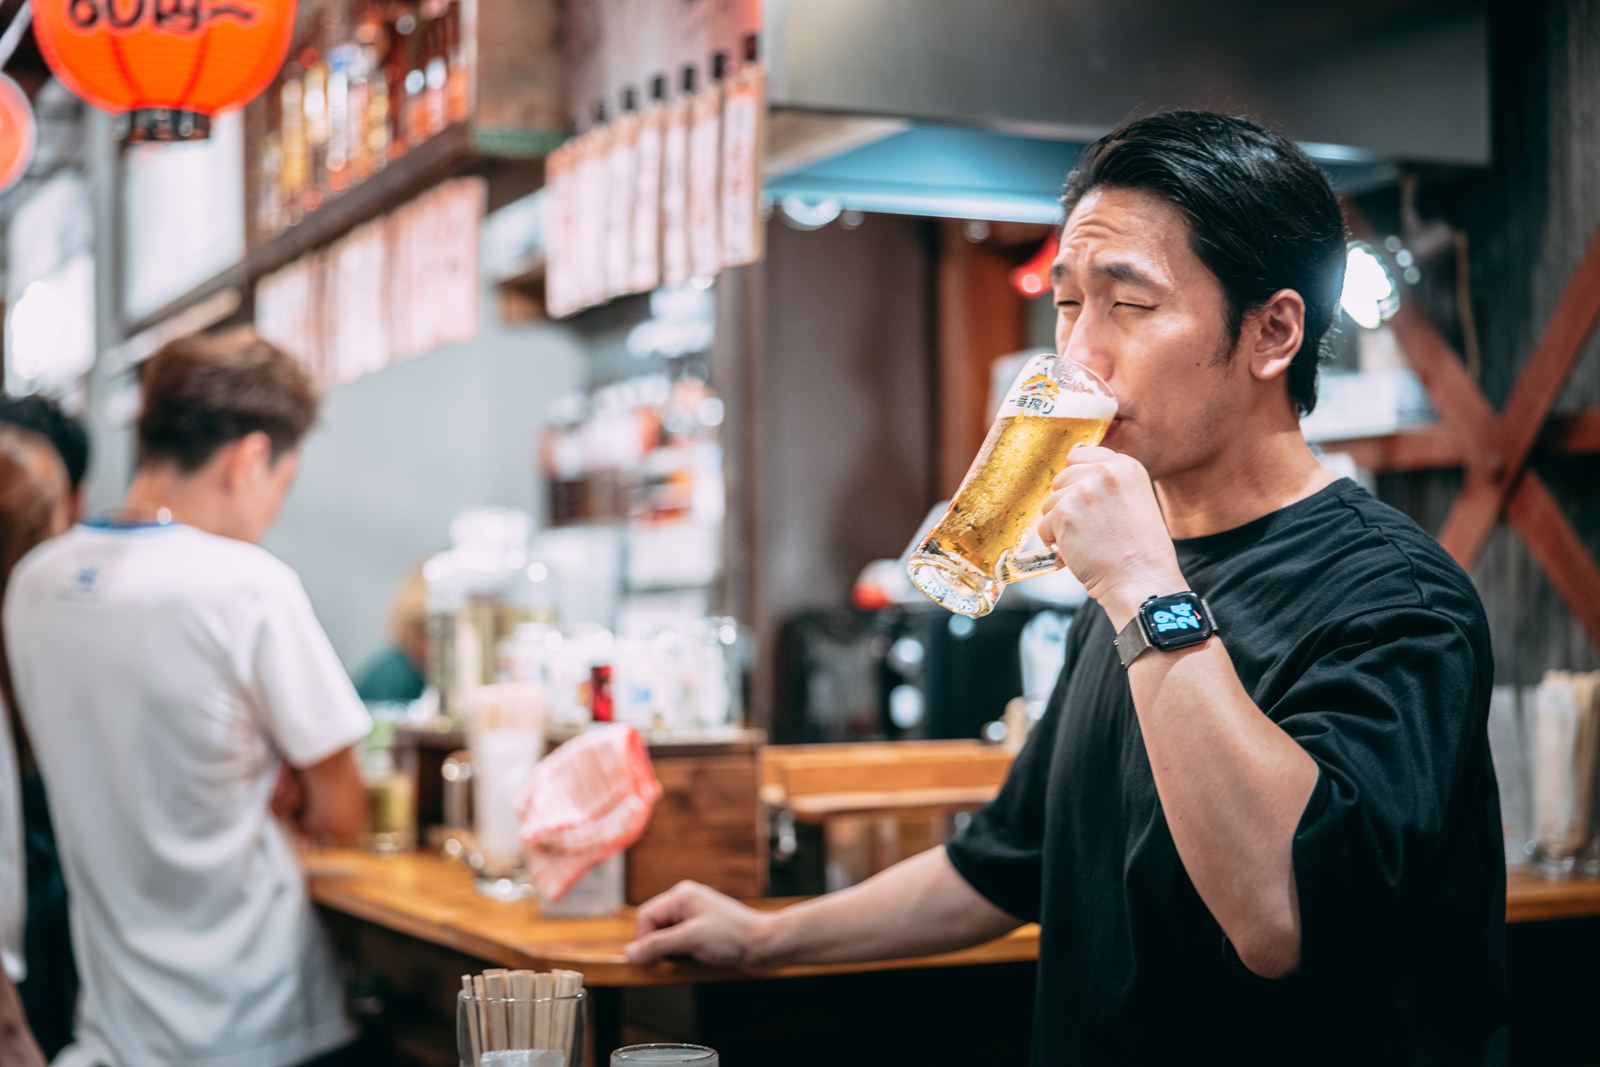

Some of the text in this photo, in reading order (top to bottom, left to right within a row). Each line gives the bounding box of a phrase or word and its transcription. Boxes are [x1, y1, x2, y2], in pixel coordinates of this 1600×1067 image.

[1008, 395, 1055, 415] 一番搾り
[1153, 610, 1178, 632] 19
[1170, 602, 1200, 629] 24
